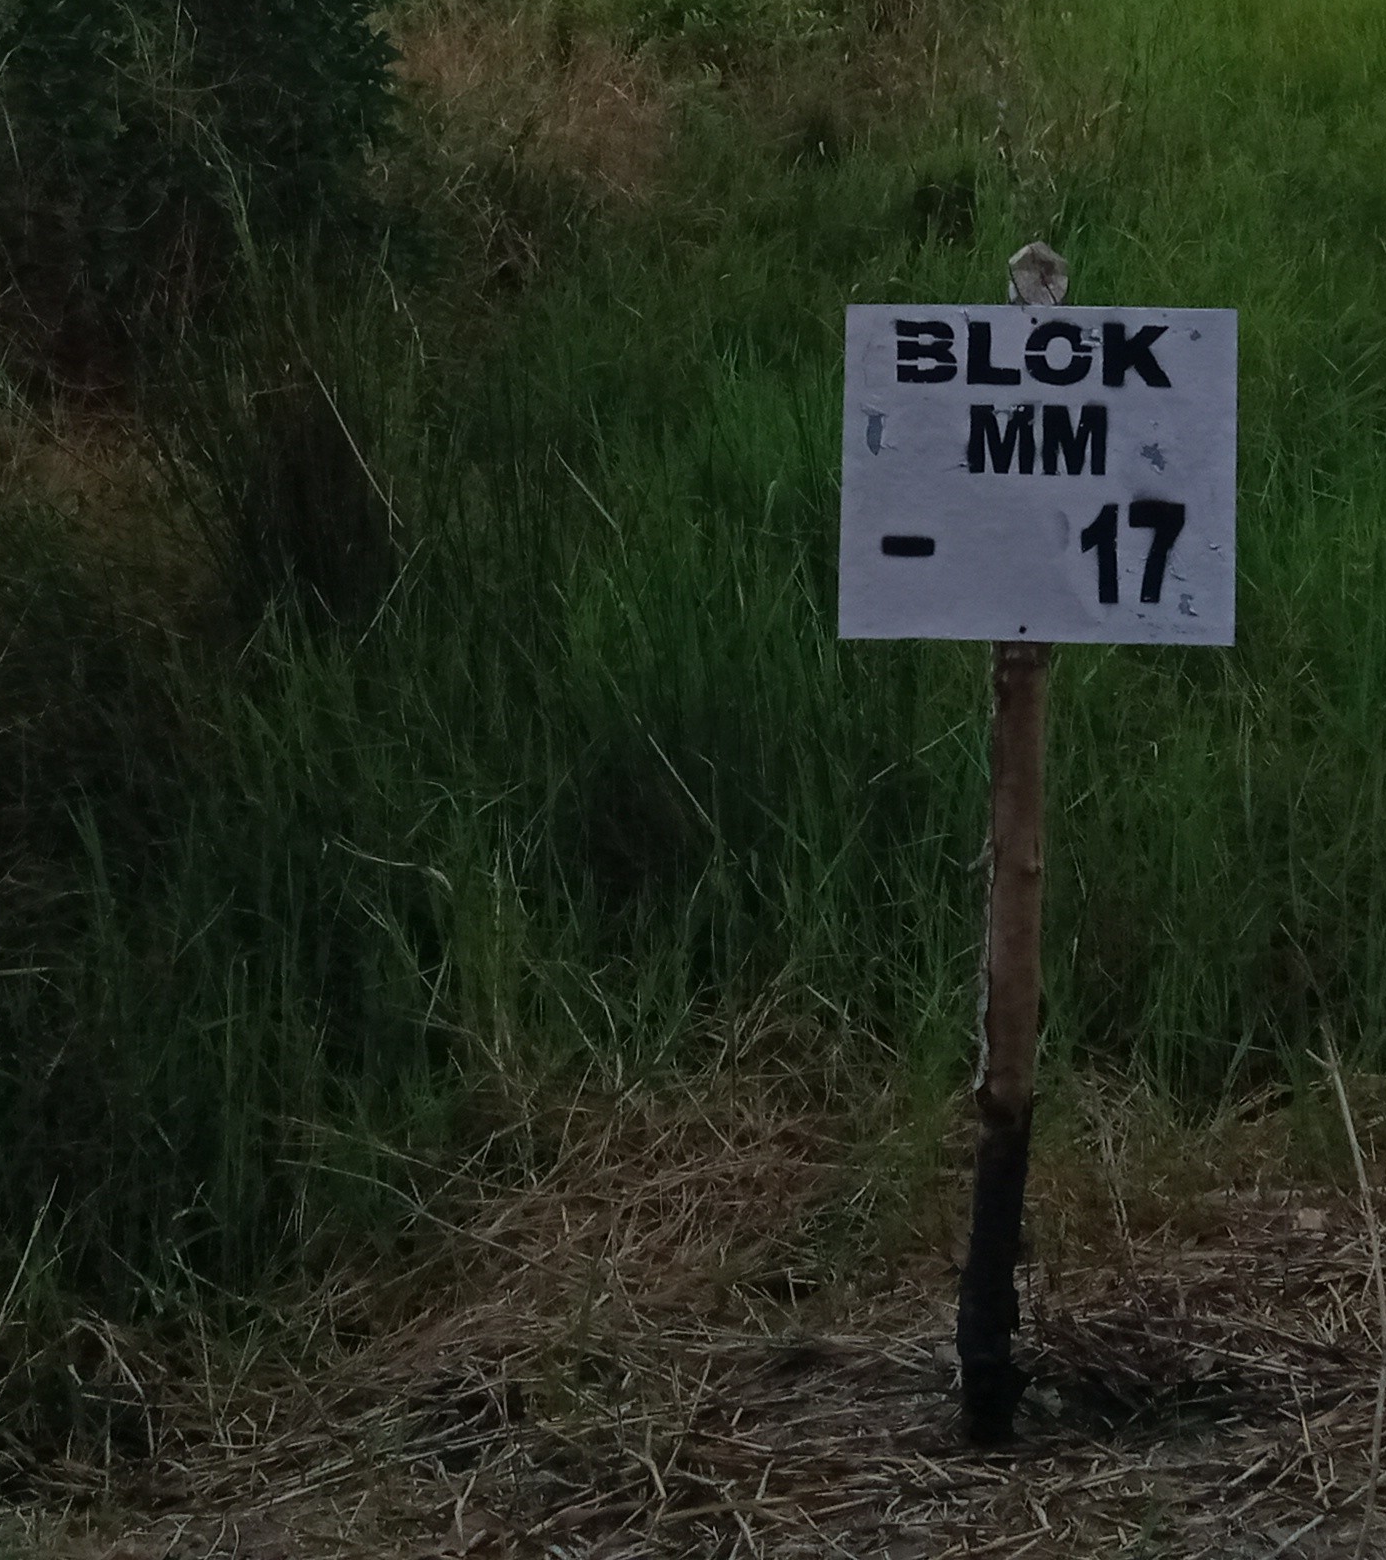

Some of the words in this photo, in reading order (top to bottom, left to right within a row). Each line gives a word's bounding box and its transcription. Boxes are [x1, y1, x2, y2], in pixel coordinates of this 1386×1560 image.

[896, 319, 1172, 388] BLOK
[967, 404, 1108, 476] MM
[1080, 499, 1186, 604] 17
